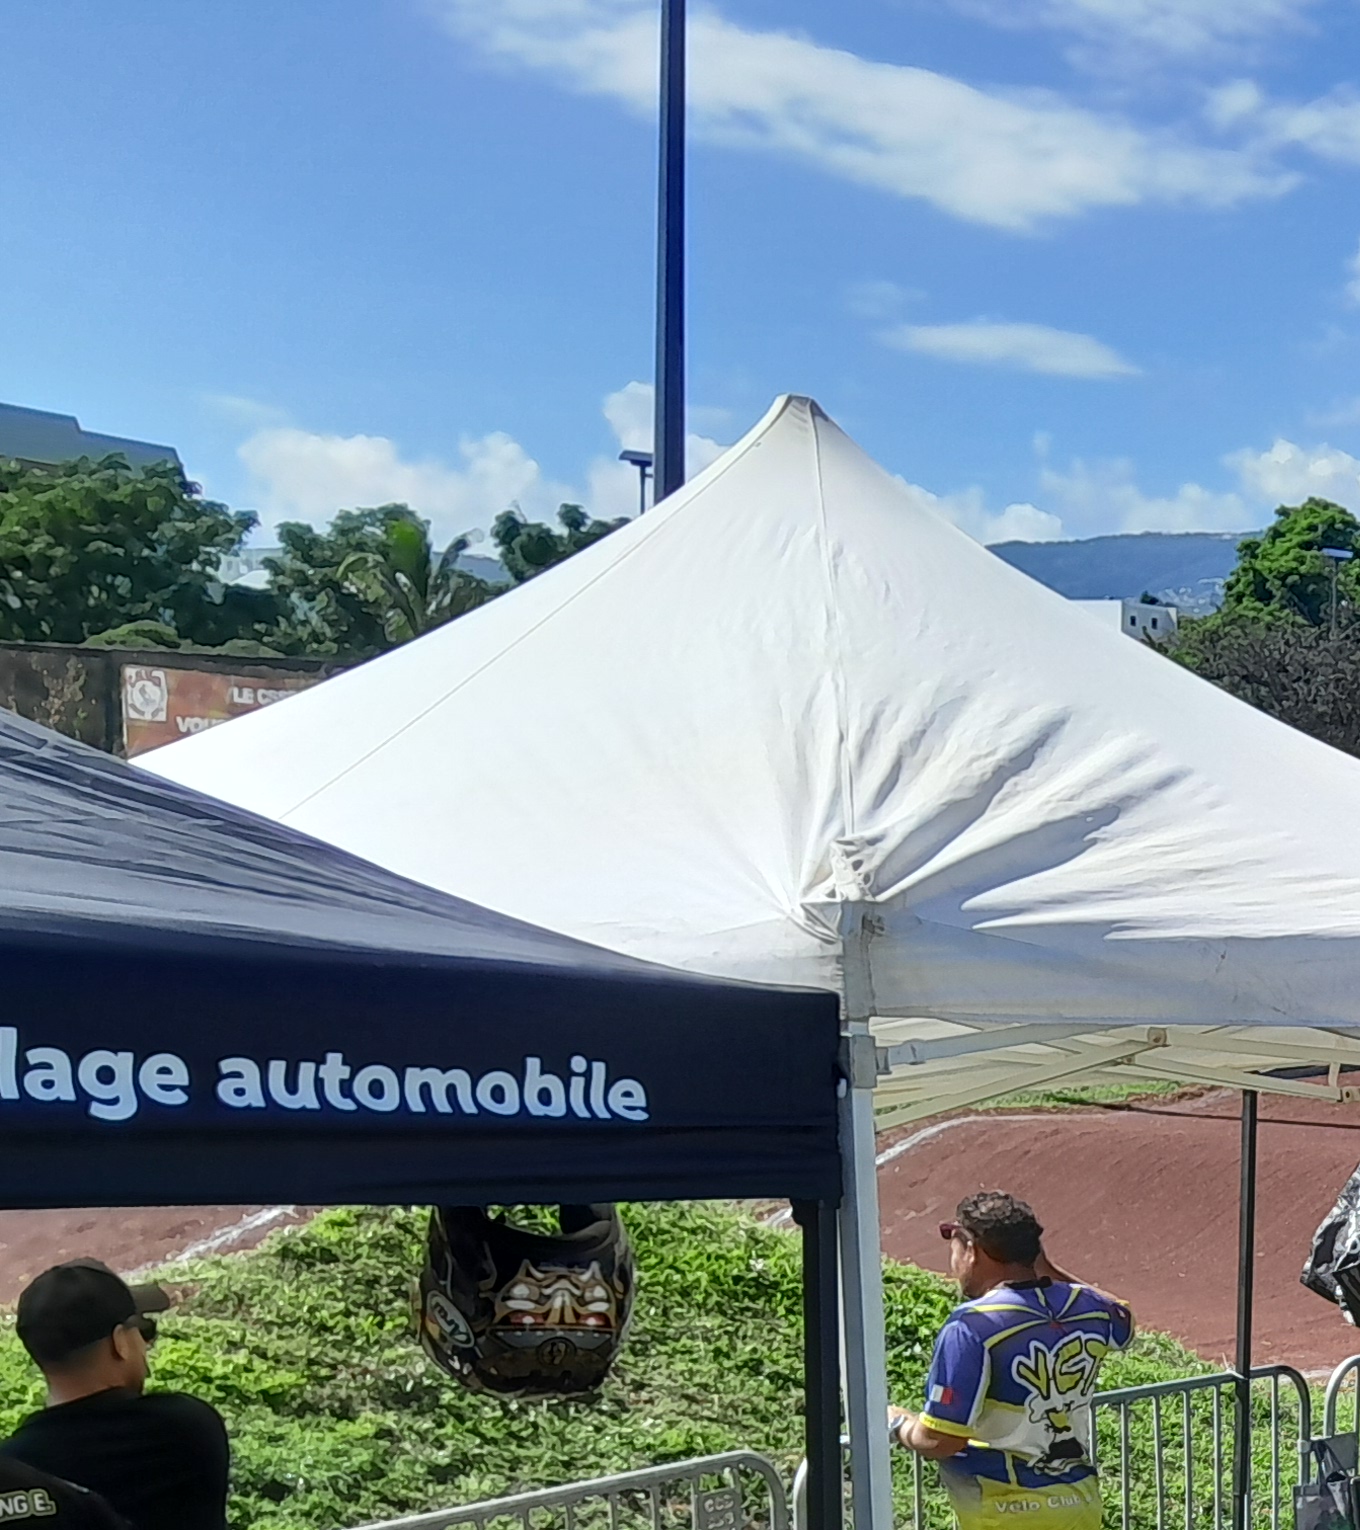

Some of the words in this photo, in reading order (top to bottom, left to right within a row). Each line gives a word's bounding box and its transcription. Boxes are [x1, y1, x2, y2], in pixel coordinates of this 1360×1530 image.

[232, 686, 255, 704] LE
[216, 1051, 650, 1122] automobile
[995, 1501, 1040, 1514] Velo
